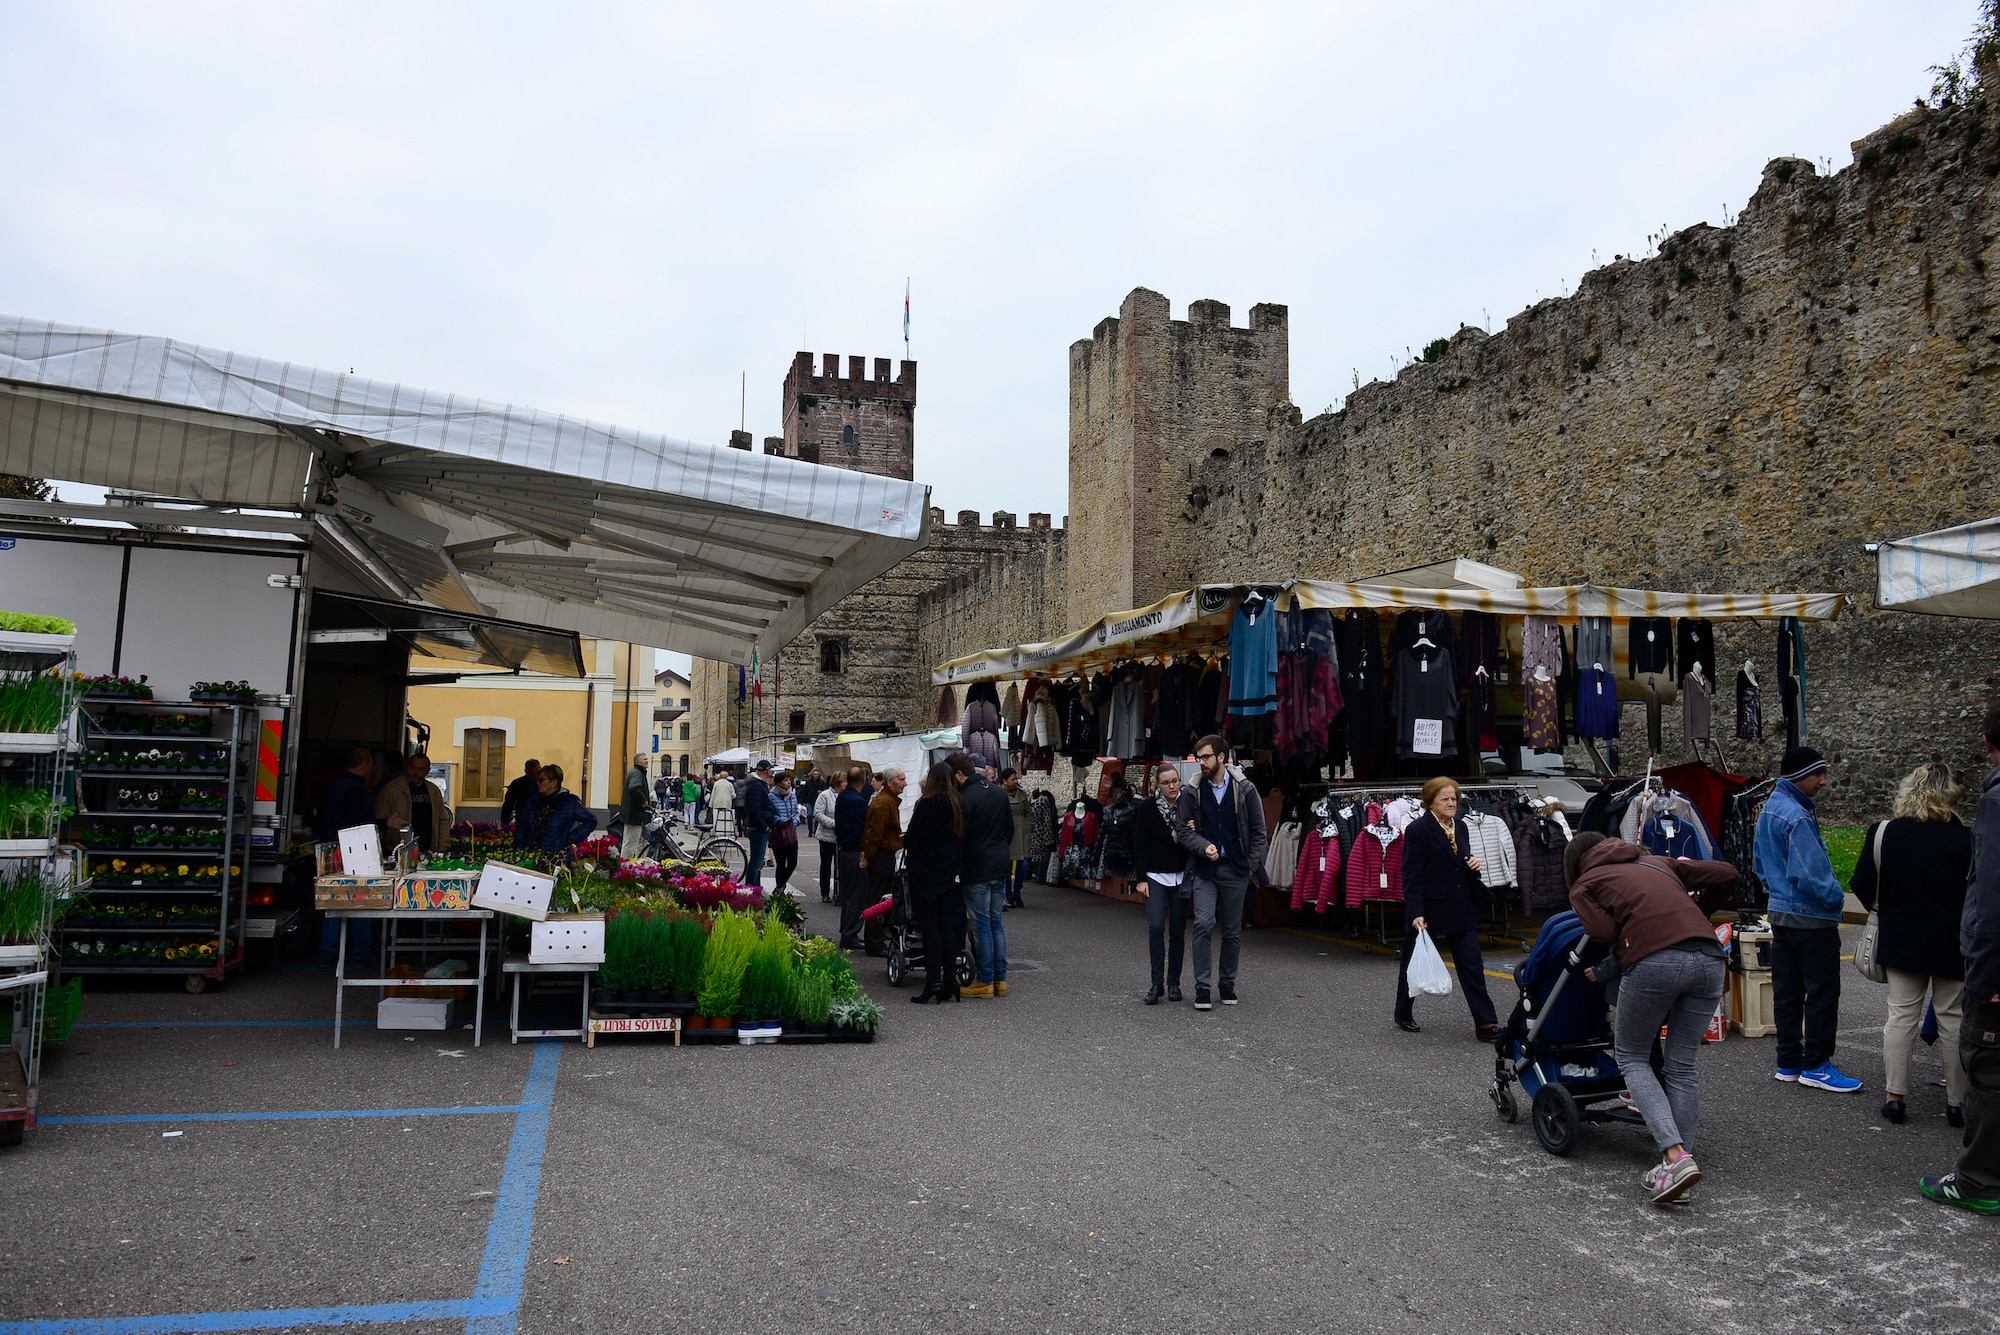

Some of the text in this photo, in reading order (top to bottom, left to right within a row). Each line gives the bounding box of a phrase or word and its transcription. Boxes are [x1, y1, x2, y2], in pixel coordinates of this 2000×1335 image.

[1205, 594, 1225, 606] K.G.
[1111, 612, 1162, 636] ABBIGLIAMENTO
[603, 1020, 667, 1031] TALOS FRUIT
